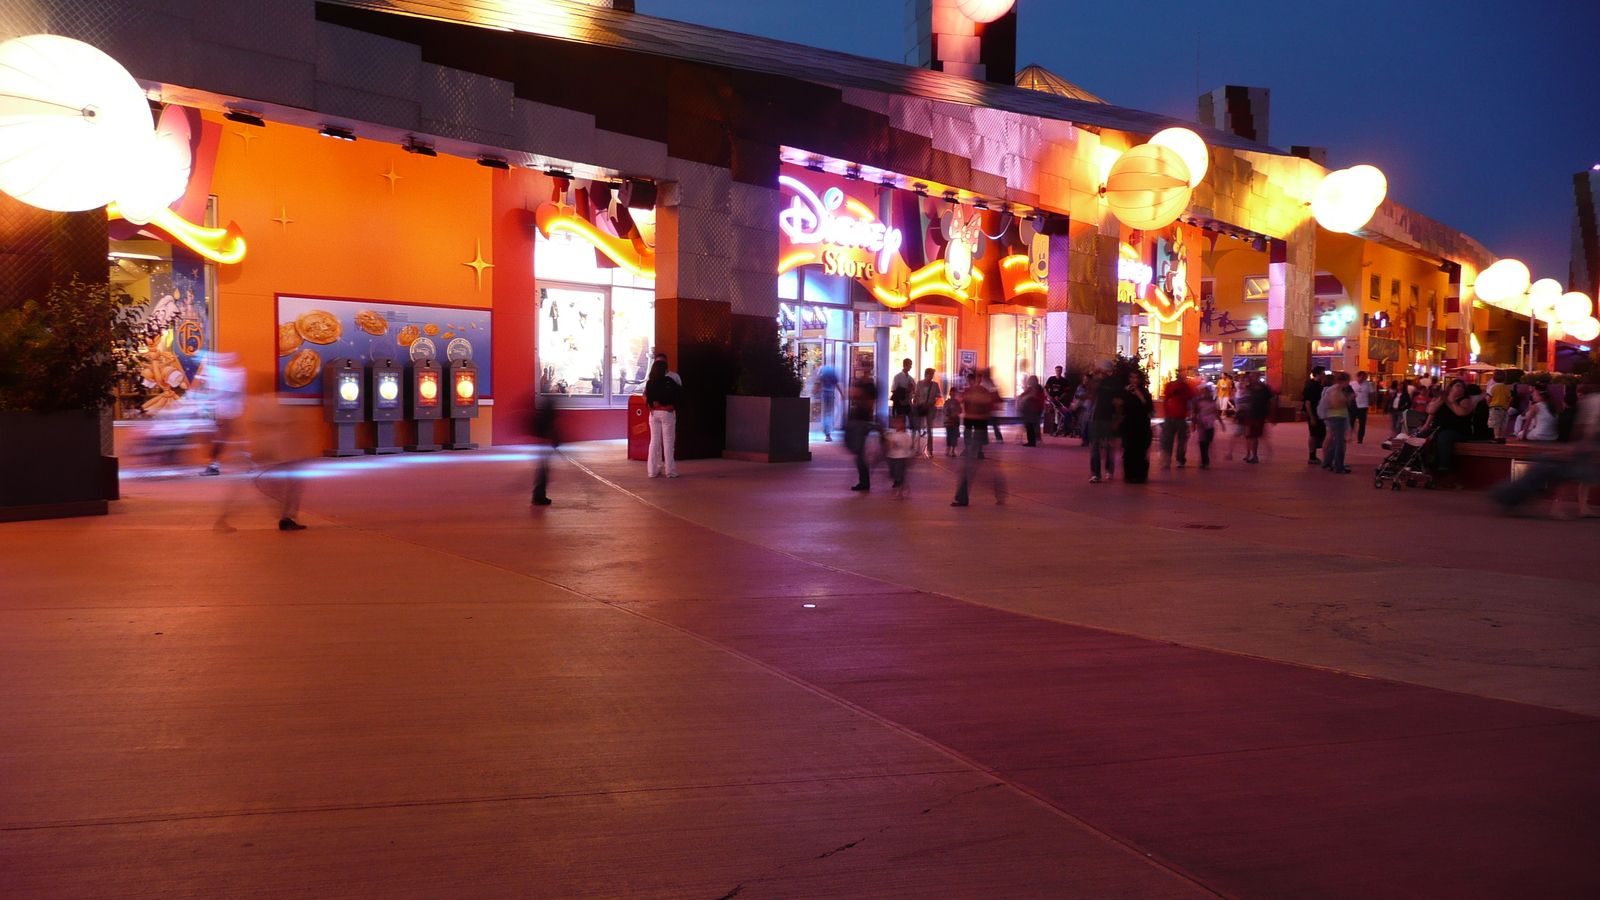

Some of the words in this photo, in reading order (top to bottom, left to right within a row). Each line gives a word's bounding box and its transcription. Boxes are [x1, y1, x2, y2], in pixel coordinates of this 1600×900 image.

[778, 175, 902, 273] Disney
[824, 249, 874, 279] Store
[178, 322, 202, 355] 15
